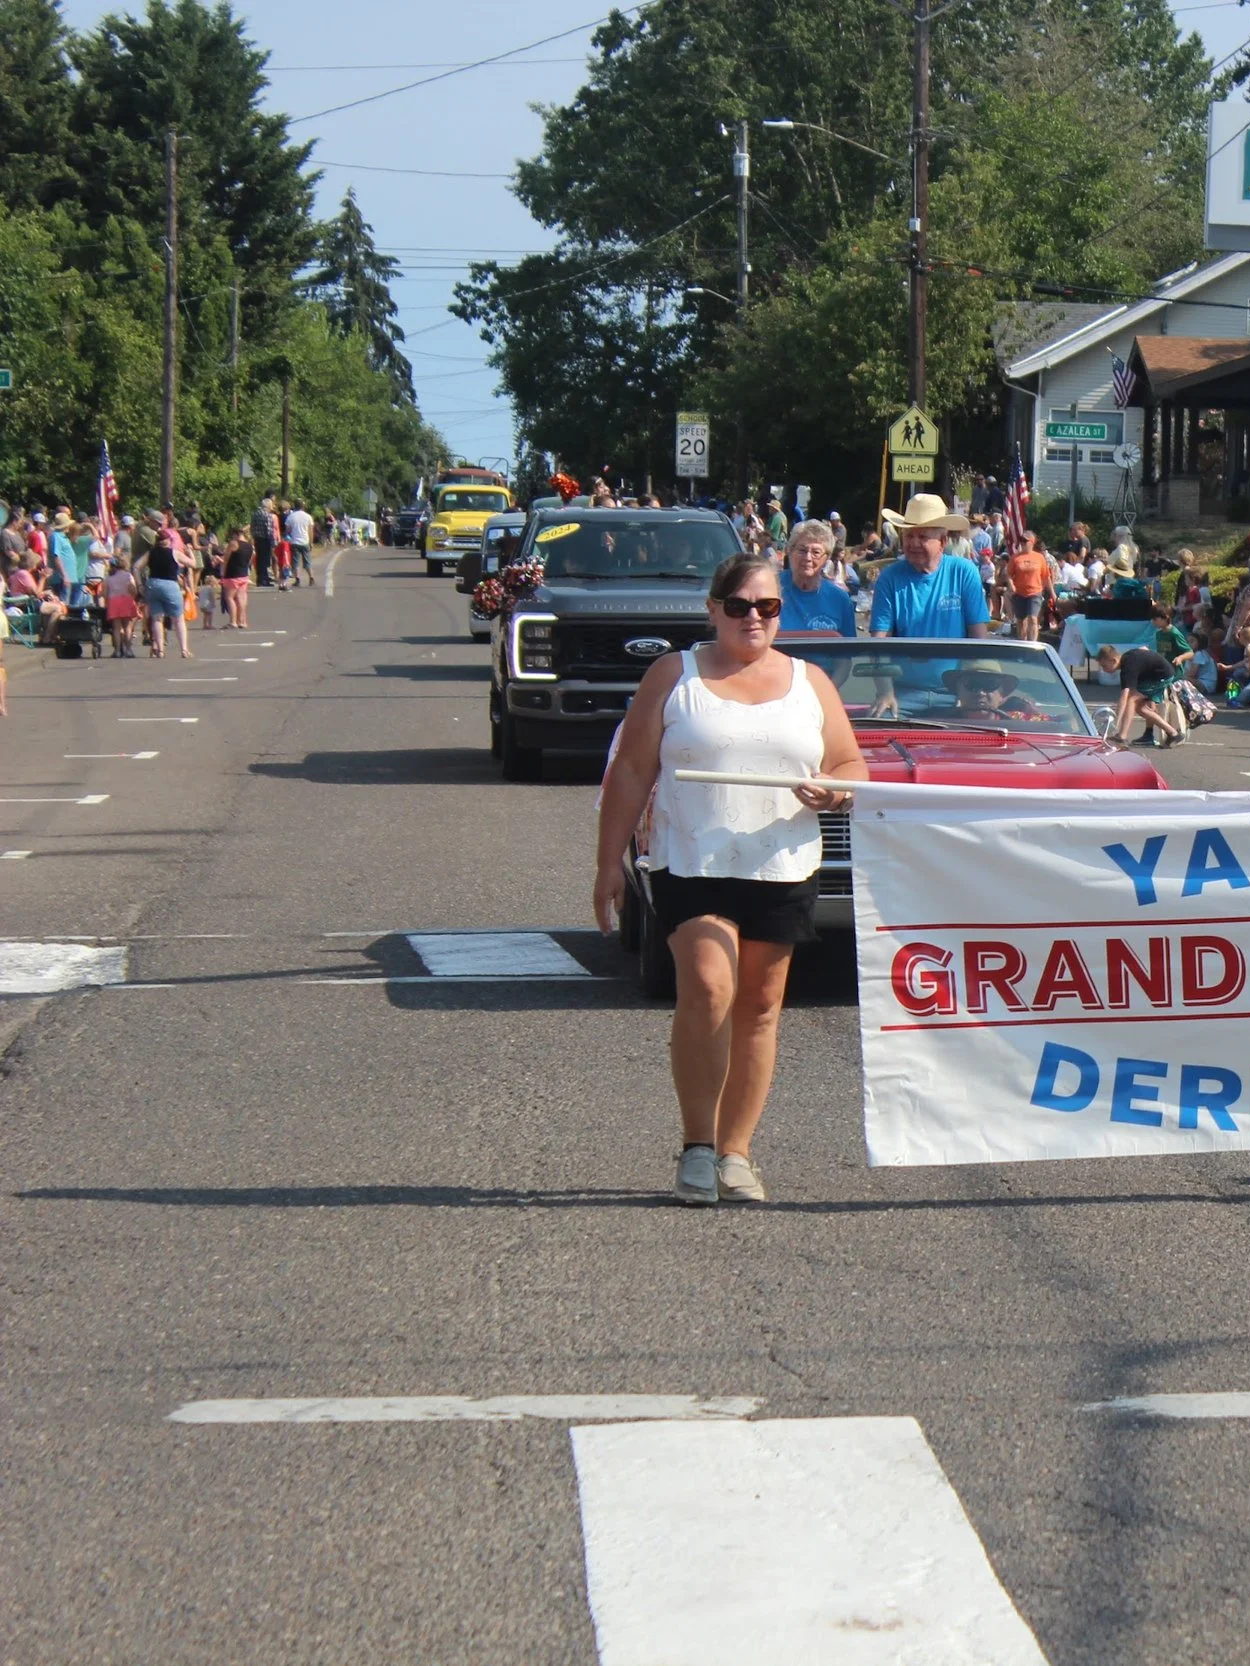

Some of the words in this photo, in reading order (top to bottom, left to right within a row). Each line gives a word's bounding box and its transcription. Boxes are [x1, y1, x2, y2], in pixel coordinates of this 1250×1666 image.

[679, 414, 707, 422] SCHOOL
[680, 427, 706, 437] SPEED
[1056, 425, 1091, 436] AZALEA
[680, 438, 706, 456] 20
[896, 464, 930, 474] AHEAD
[891, 935, 1247, 1017] GRAND
